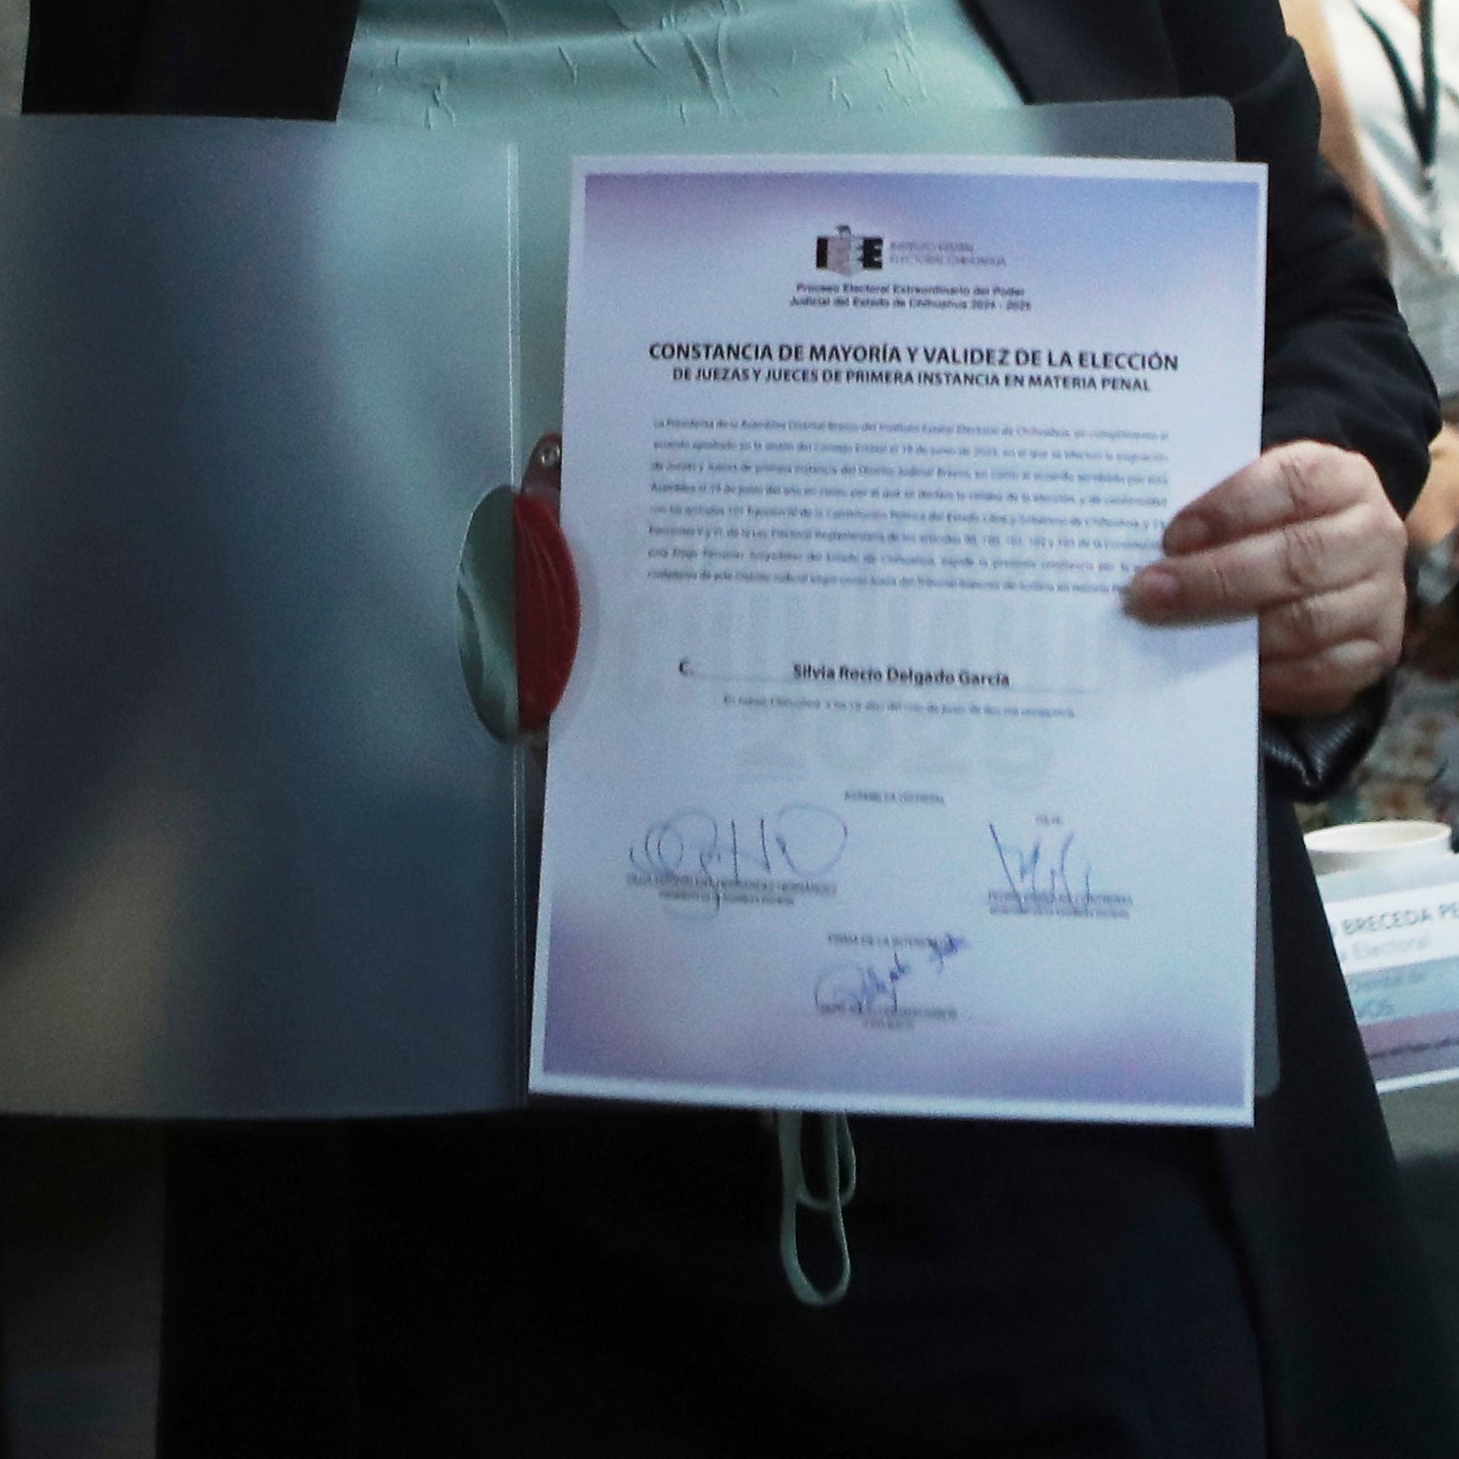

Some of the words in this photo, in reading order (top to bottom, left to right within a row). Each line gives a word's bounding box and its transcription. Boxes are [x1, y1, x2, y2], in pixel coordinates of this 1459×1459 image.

[648, 342, 773, 362] CONSTANCIA
[778, 343, 804, 362] DE
[809, 341, 902, 364] MAYORÍA
[906, 346, 919, 364] Y
[923, 346, 1010, 367] VALIDEZ
[1015, 348, 1044, 368] DE
[1048, 350, 1074, 369] LA
[1078, 350, 1179, 372] ELECCIÓN
[673, 367, 691, 381] DE
[694, 367, 750, 382] JUEZAS
[750, 368, 762, 382] Y
[765, 368, 818, 384] JUECES
[822, 369, 842, 383] DE
[846, 369, 913, 385] PRIMERA
[917, 371, 1000, 388] INSTANCIA
[1004, 373, 1025, 388] EN
[1028, 374, 1096, 390] MATERIA
[1101, 376, 1151, 392] PENAL
[792, 662, 835, 682] Silvia
[886, 665, 955, 688] Delgado
[1342, 907, 1433, 937] BRECEDA
